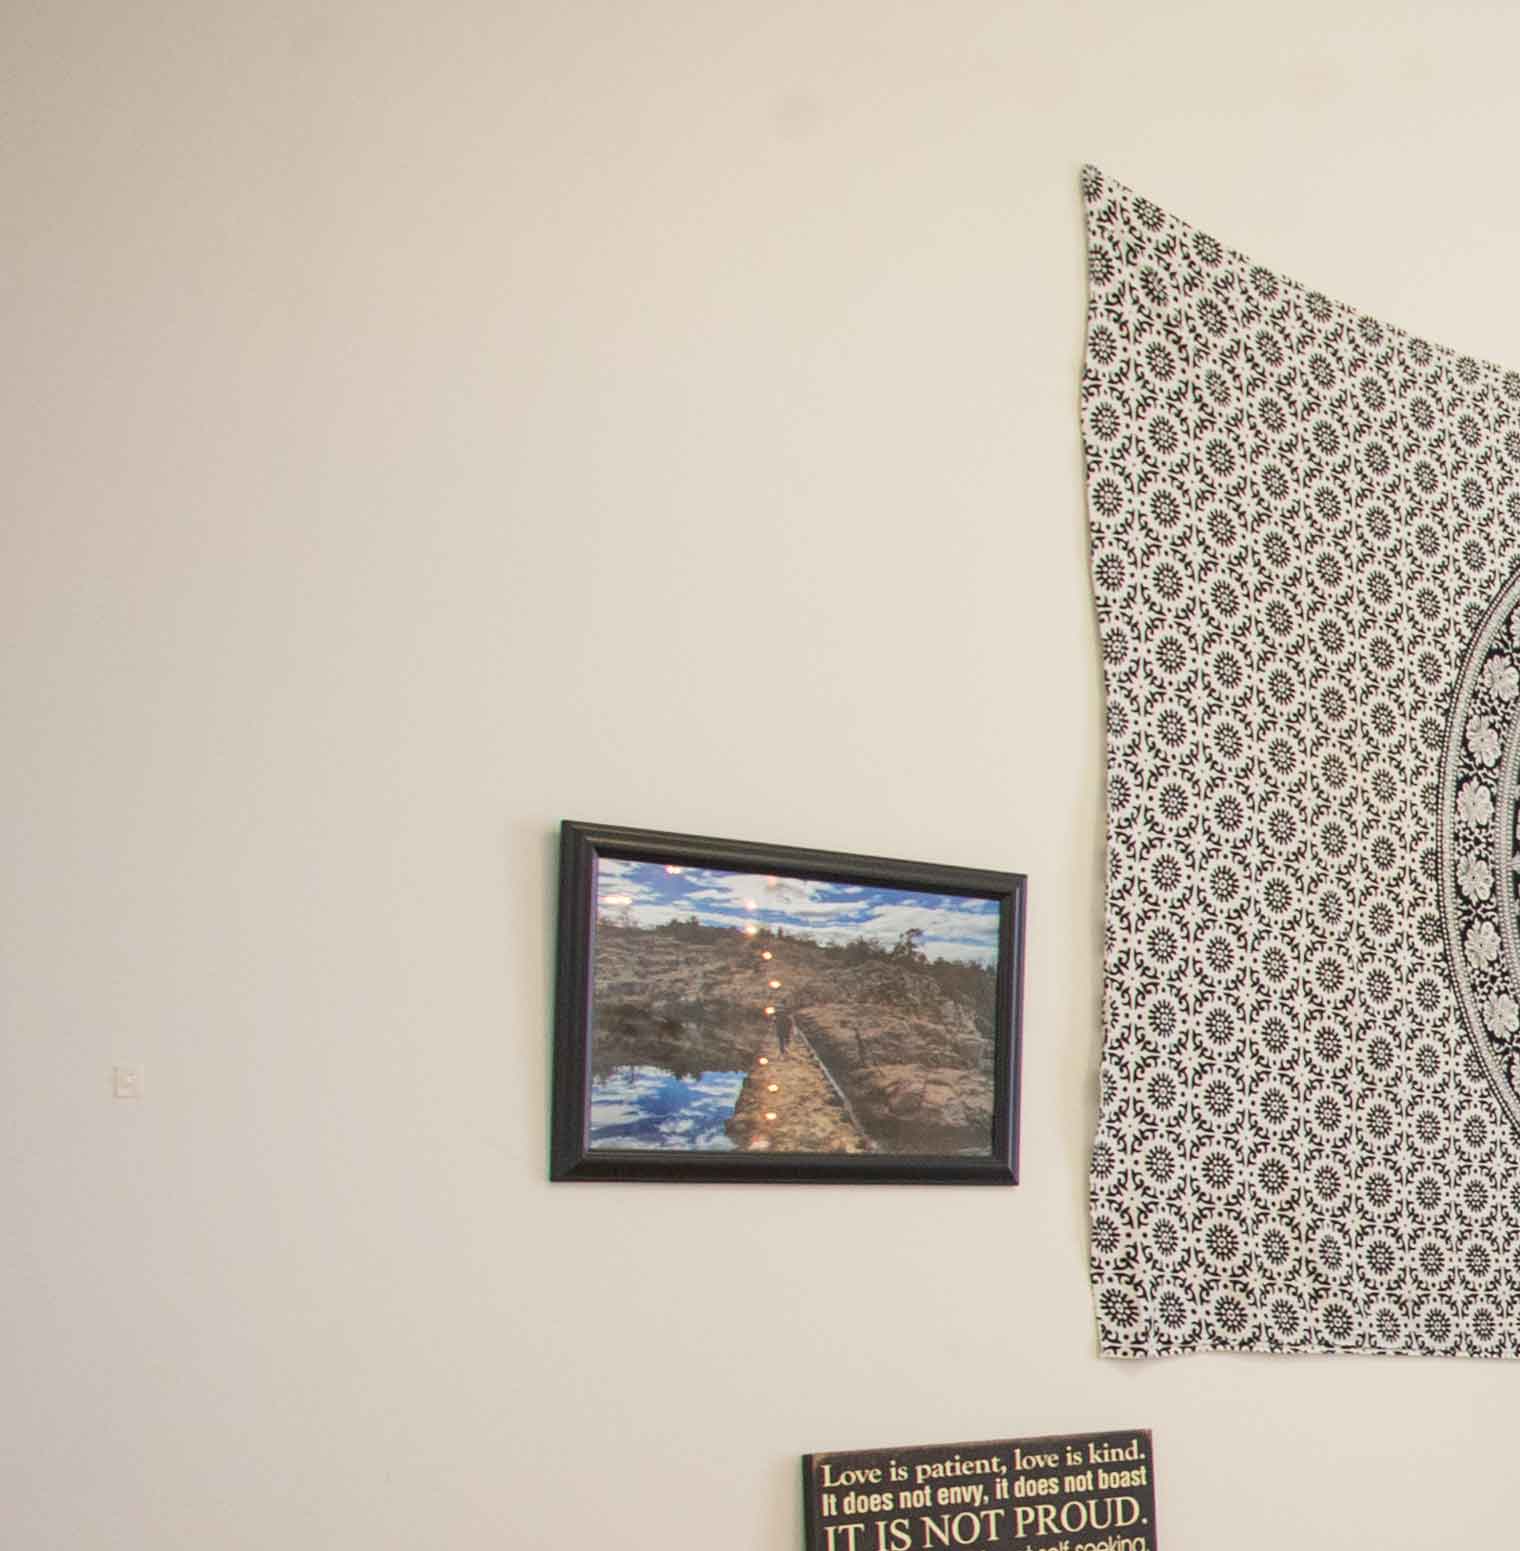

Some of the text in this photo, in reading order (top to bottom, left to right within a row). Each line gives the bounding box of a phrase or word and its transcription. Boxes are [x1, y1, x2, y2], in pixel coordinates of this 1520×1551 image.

[821, 1439, 1145, 1487] Love is patient, love is kind.
[822, 1466, 1147, 1516] It does not envy, it does not boast
[920, 1509, 1004, 1548] NOT
[1014, 1496, 1147, 1538] PROUD.
